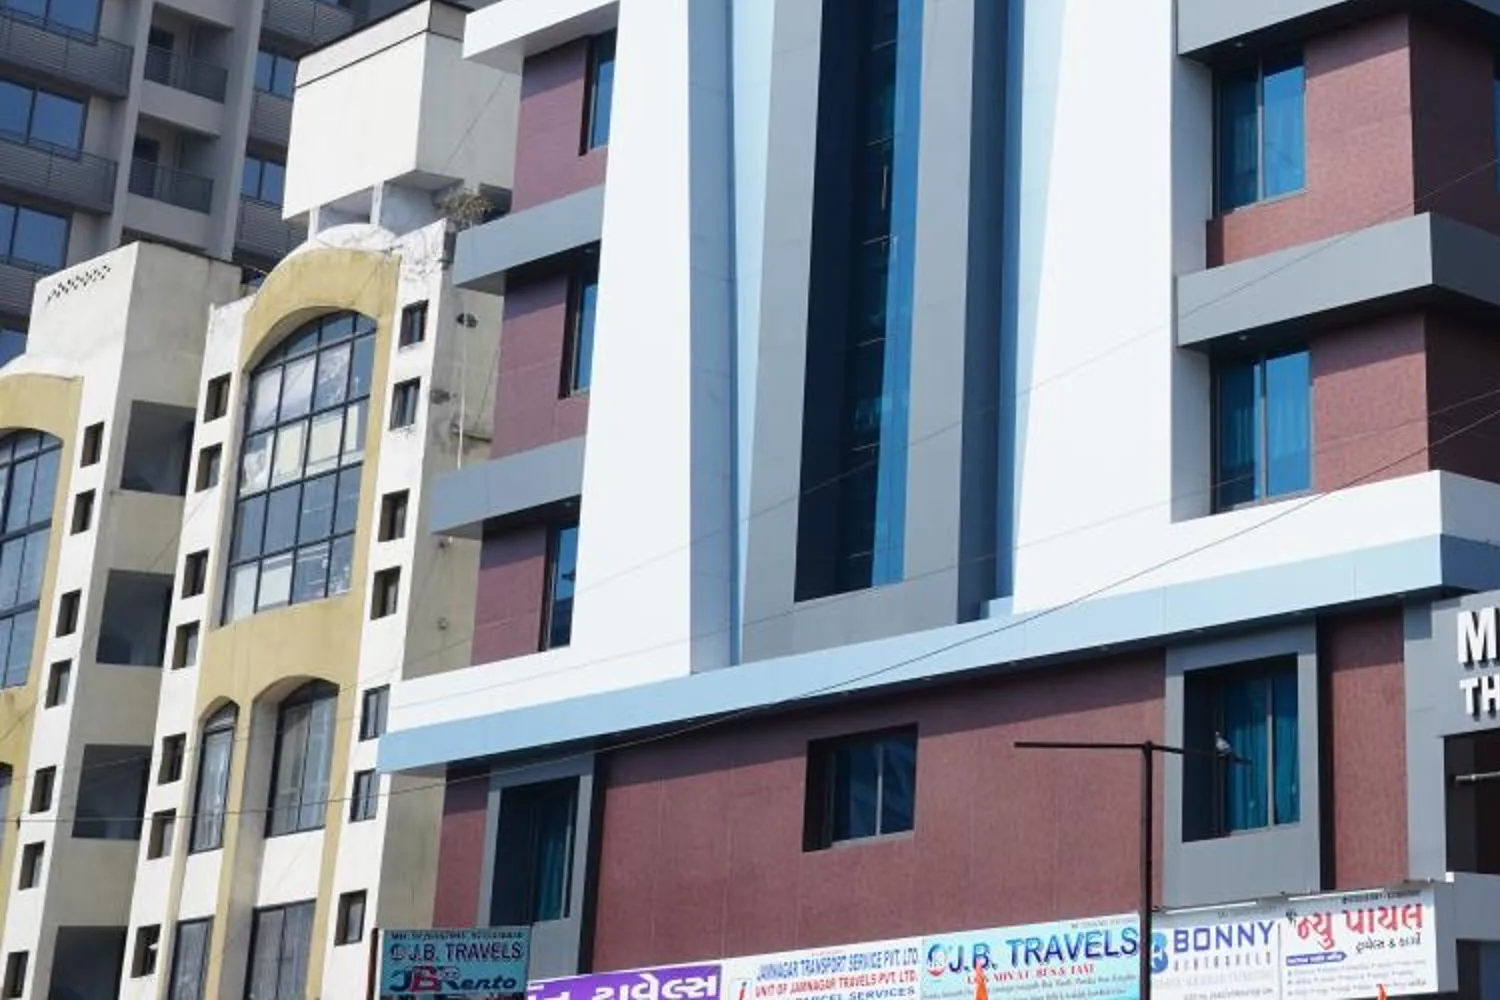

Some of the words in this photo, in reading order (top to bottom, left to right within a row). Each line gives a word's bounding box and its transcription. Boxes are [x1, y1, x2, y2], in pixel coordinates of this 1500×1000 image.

[1342, 903, 1423, 934] પાયલ
[1006, 927, 1139, 968] TRAVELS
[1174, 920, 1274, 953] BONNY
[445, 941, 523, 961] TRAVELS
[839, 973, 877, 990] TRAVELS
[849, 986, 916, 1000] SERVICES
